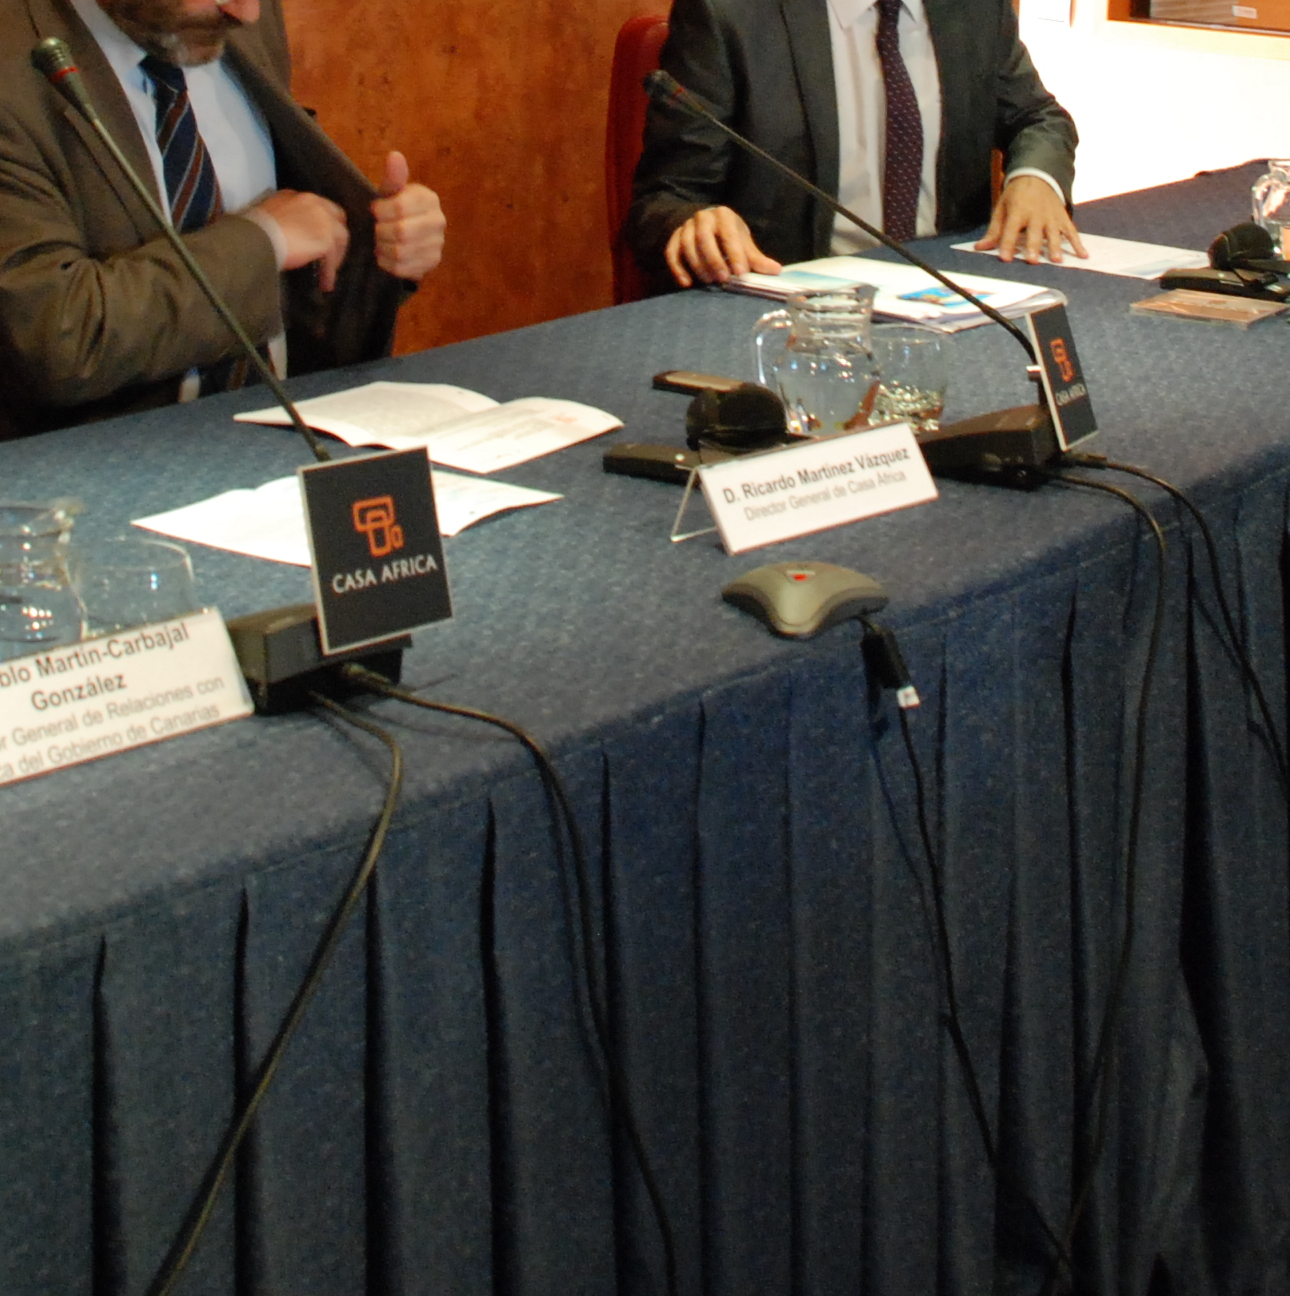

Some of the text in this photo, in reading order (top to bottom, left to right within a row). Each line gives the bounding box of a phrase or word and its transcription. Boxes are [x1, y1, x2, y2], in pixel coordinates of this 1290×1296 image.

[722, 487, 741, 504] D.
[741, 475, 796, 499] Ricardo
[854, 448, 911, 470] Vázquez
[743, 500, 788, 521] Director
[788, 487, 832, 509] General
[833, 483, 847, 498] de
[847, 478, 876, 495] Casa
[332, 554, 438, 594] CASA AFRICA
[11, 710, 79, 747] General
[82, 704, 104, 727] de
[105, 682, 194, 719] Relaciones
[197, 675, 226, 696] con
[31, 672, 128, 712] González
[18, 750, 45, 773] del
[47, 731, 123, 766] Gobierno
[126, 722, 148, 743] de
[150, 703, 221, 736] Canarias
